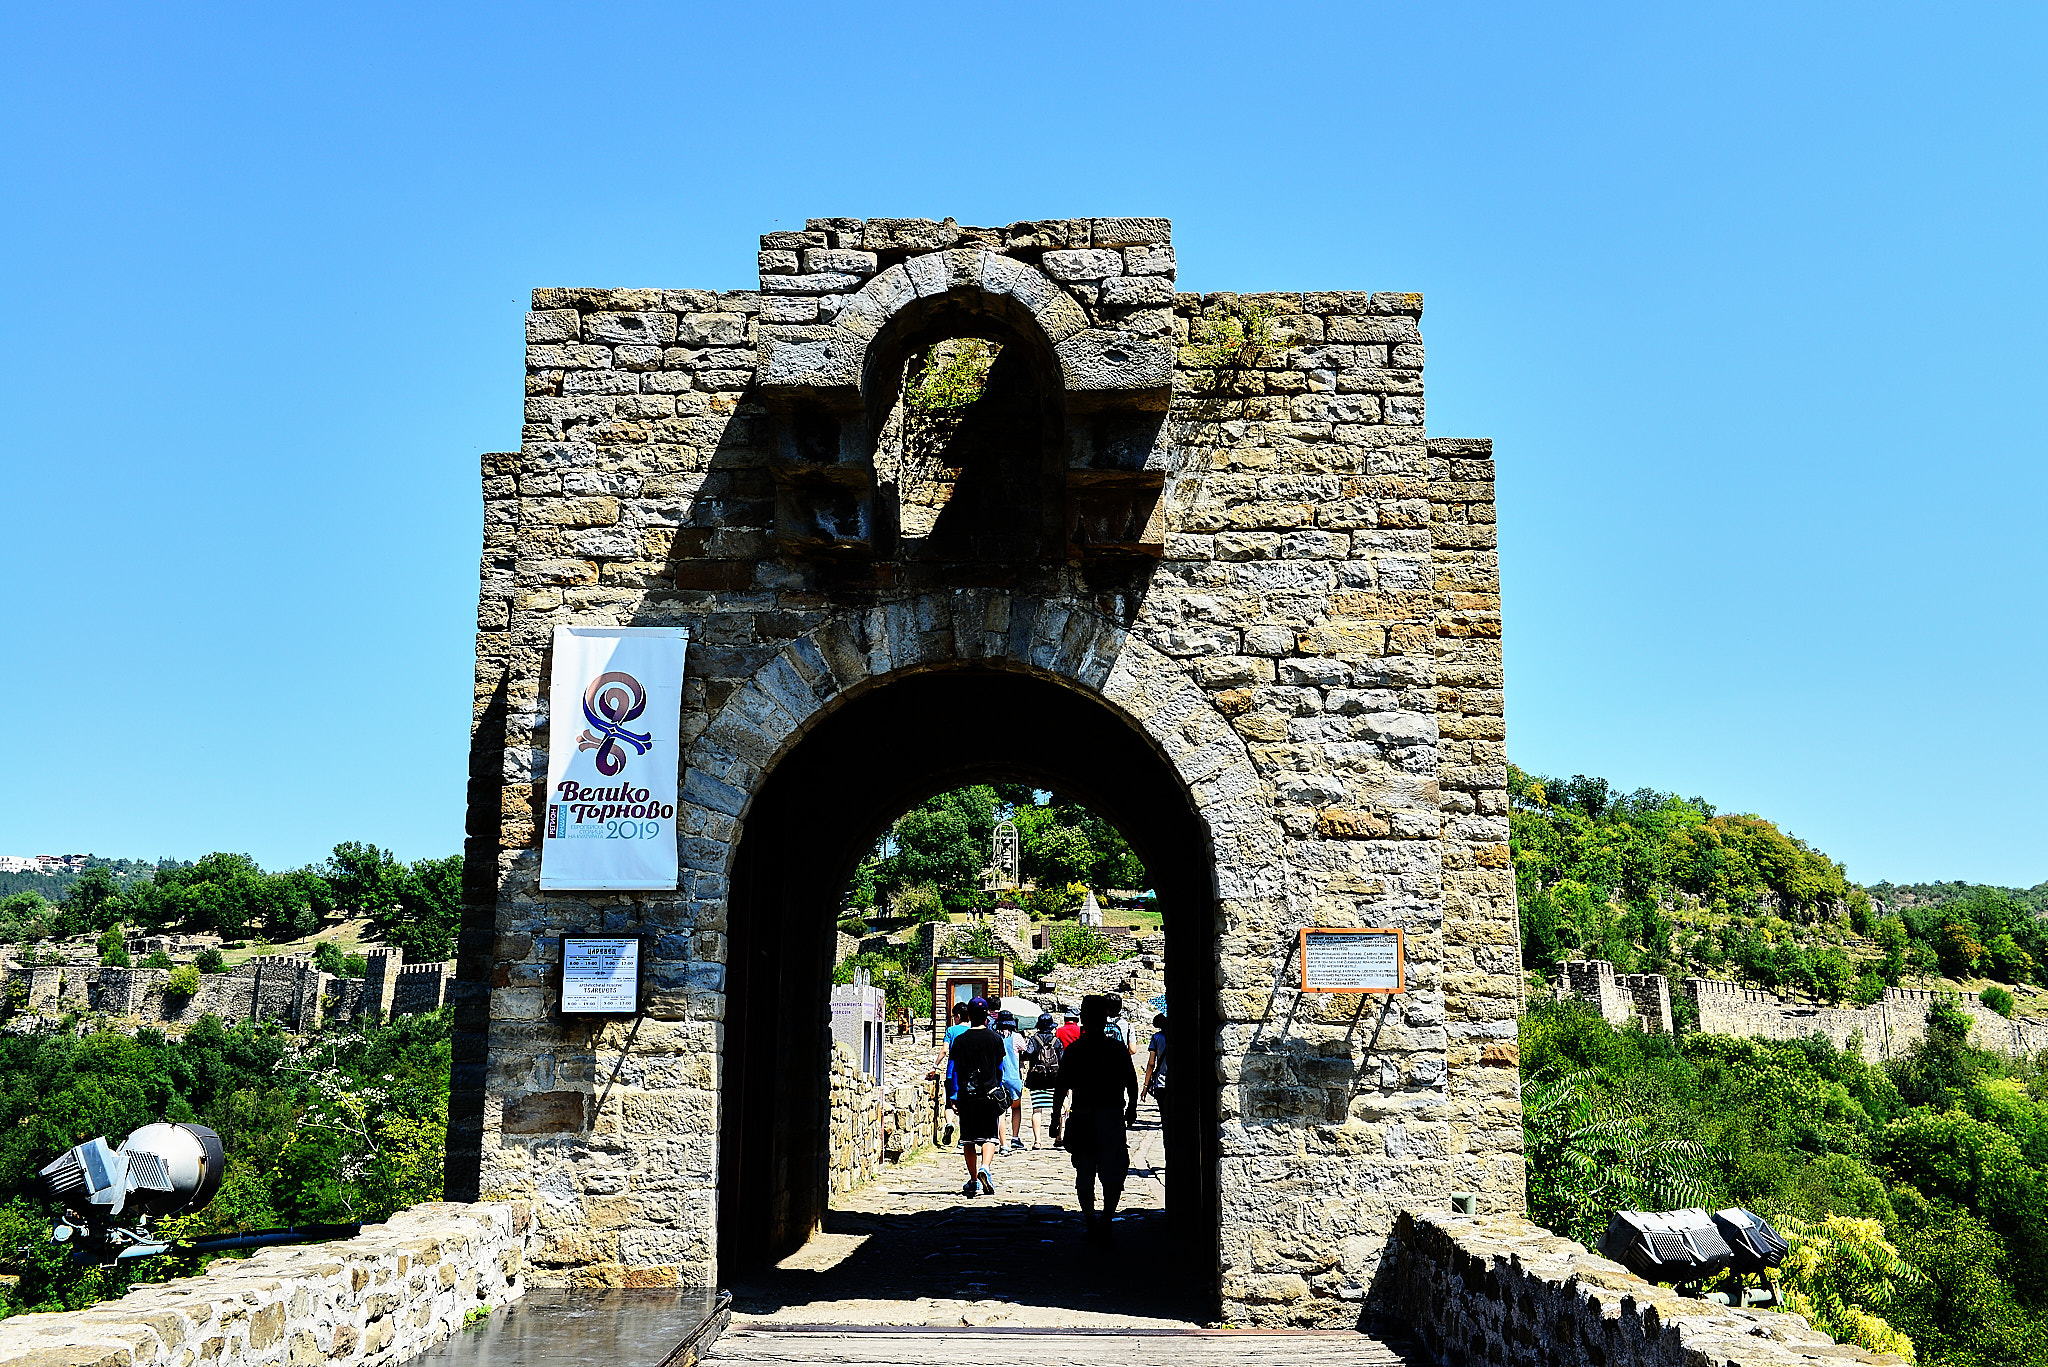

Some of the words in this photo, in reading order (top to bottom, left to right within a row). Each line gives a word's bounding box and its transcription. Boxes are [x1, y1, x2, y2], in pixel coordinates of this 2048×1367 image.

[558, 781, 650, 803] Велико
[549, 808, 557, 835] РЕГИОН
[570, 801, 674, 823] Търново
[606, 821, 660, 840] 2019
